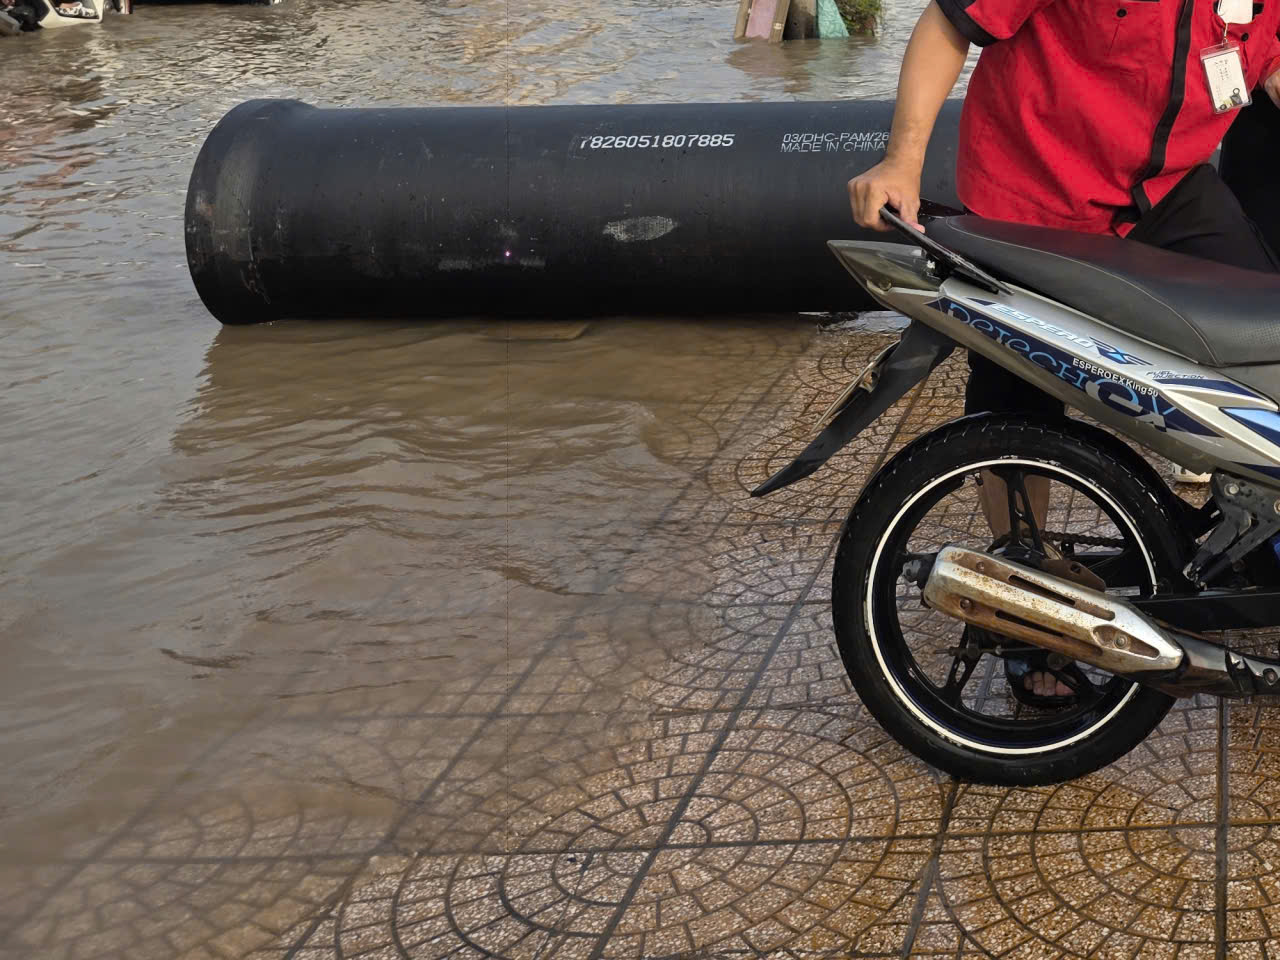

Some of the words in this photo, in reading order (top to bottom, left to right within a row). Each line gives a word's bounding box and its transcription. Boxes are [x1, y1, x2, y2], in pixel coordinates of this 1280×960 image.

[780, 142, 821, 152] MADE
[825, 142, 839, 152] IN
[843, 141, 887, 152] CHINA
